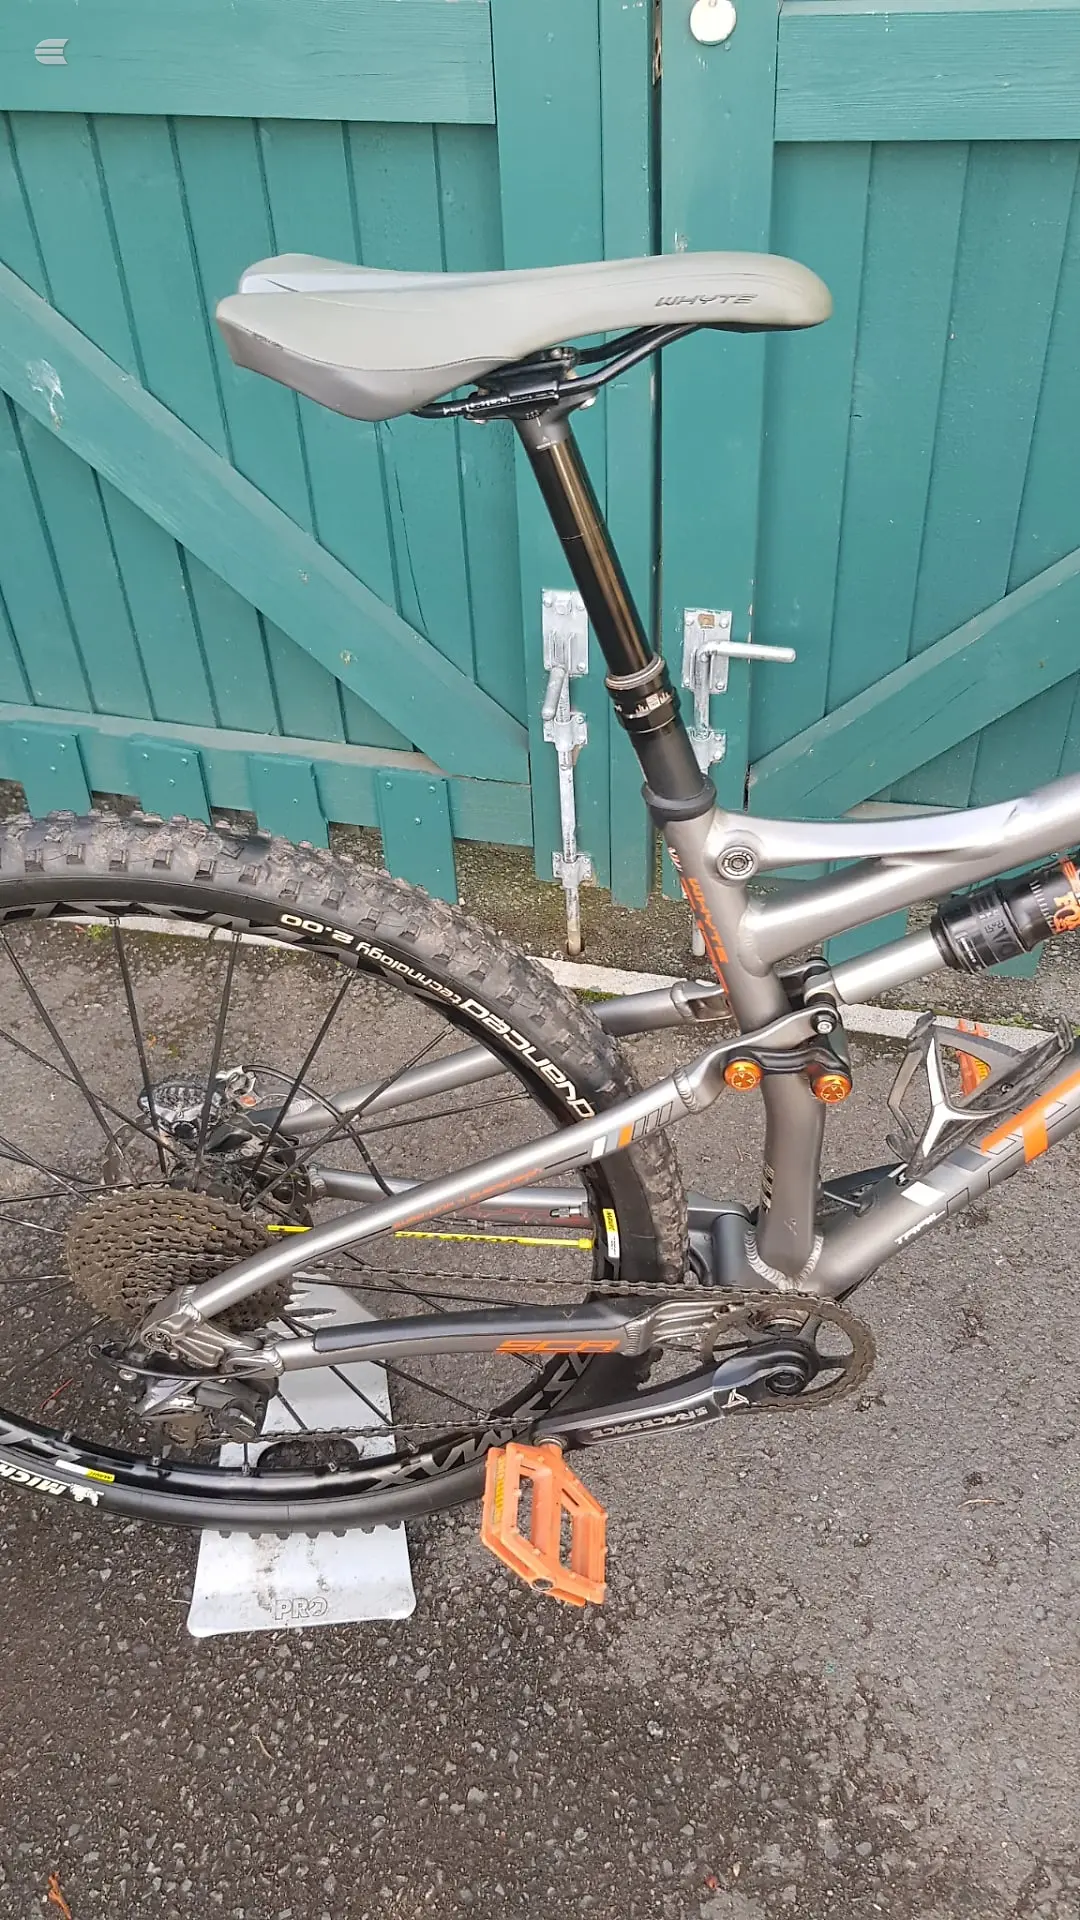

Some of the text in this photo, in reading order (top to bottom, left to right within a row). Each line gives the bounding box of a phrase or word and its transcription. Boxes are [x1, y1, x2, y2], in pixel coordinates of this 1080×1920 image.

[654, 294, 759, 307] WHYTE
[280, 913, 596, 1119] dvanced technology 2.00
[274, 1596, 328, 1620] PRO
